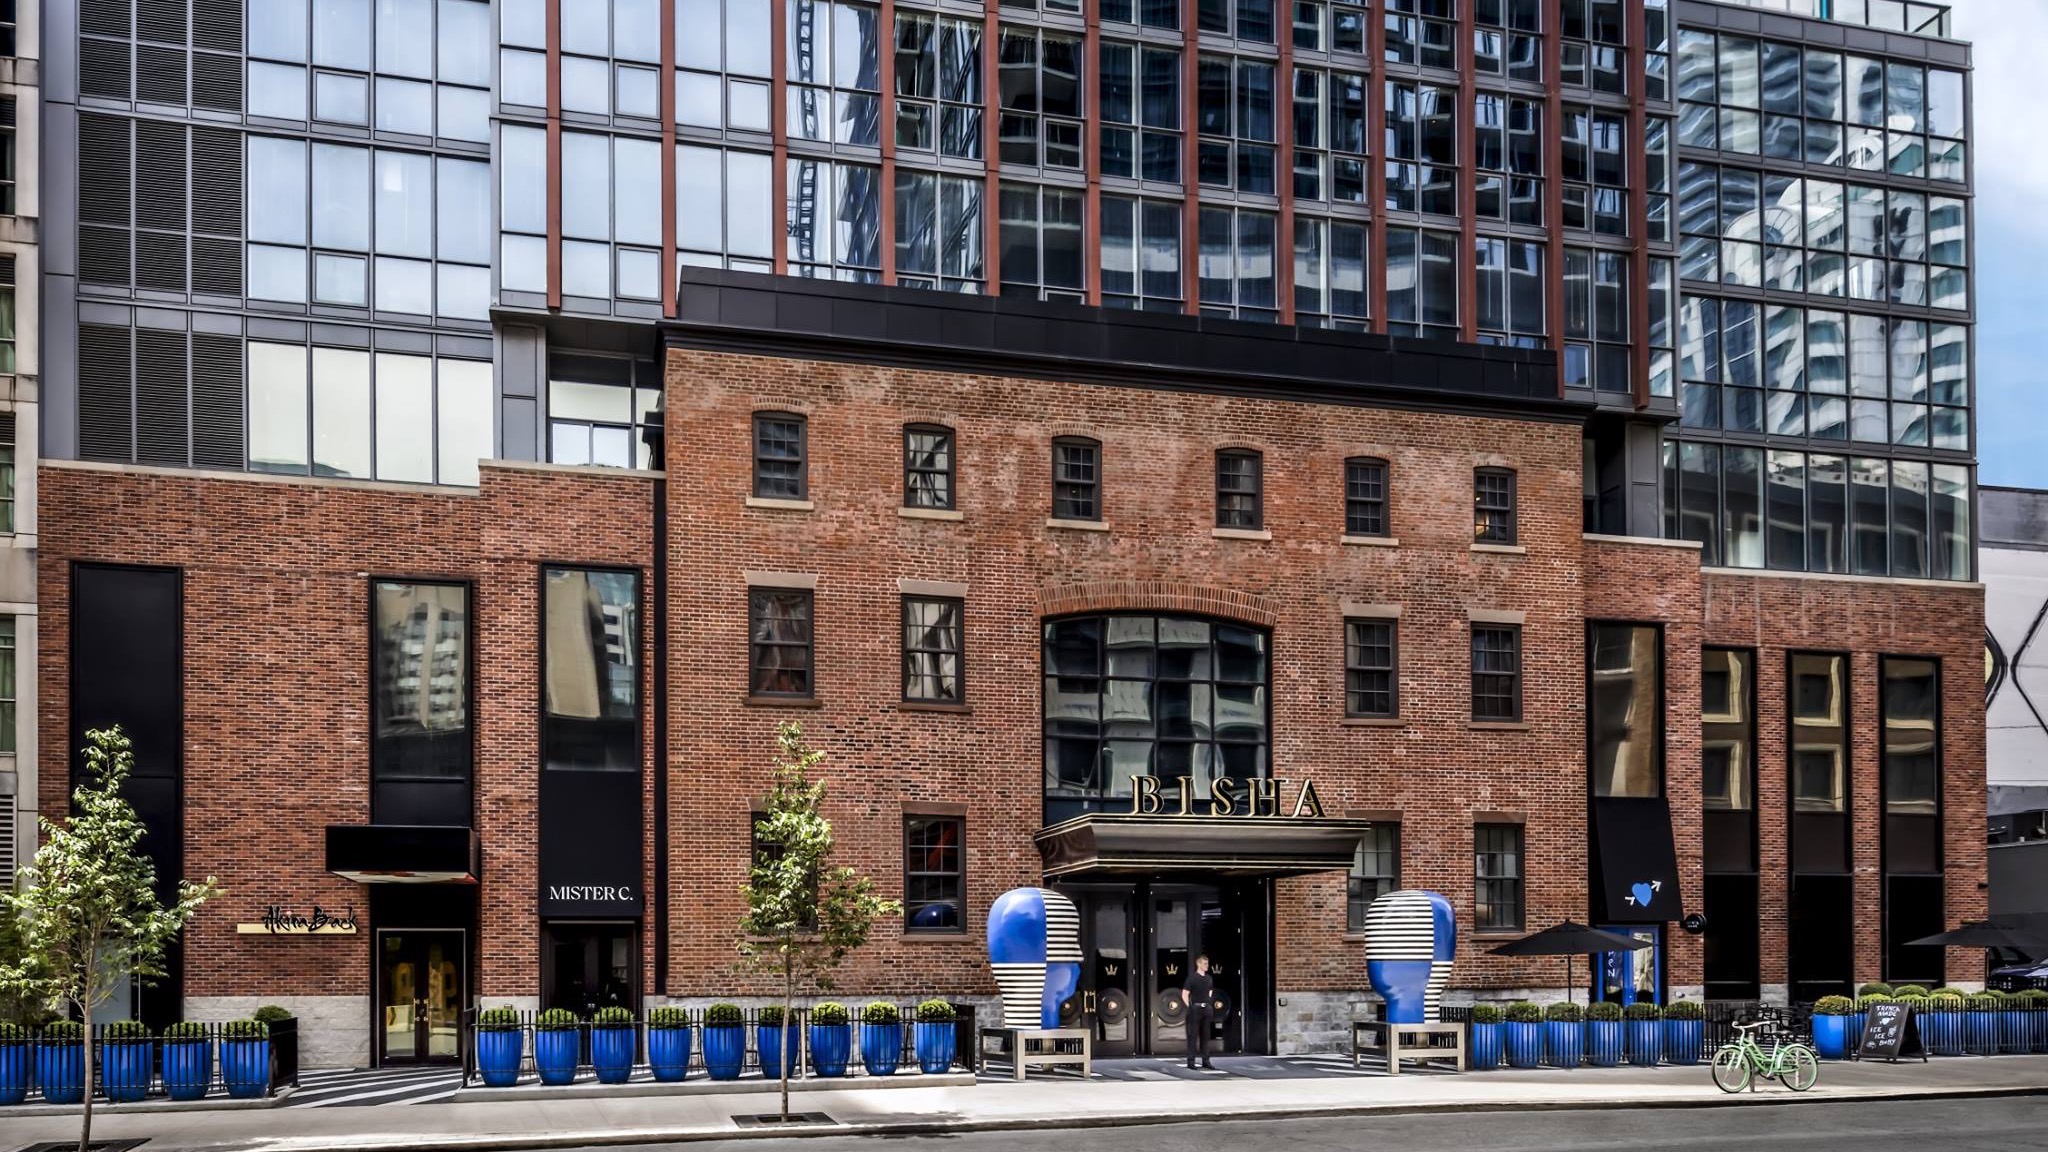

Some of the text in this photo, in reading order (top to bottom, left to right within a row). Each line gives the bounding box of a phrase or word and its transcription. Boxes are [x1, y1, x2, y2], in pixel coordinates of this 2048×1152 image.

[1129, 775, 1327, 818] BISHA
[549, 886, 634, 901] MISTER C.
[261, 905, 360, 933] Akira Back
